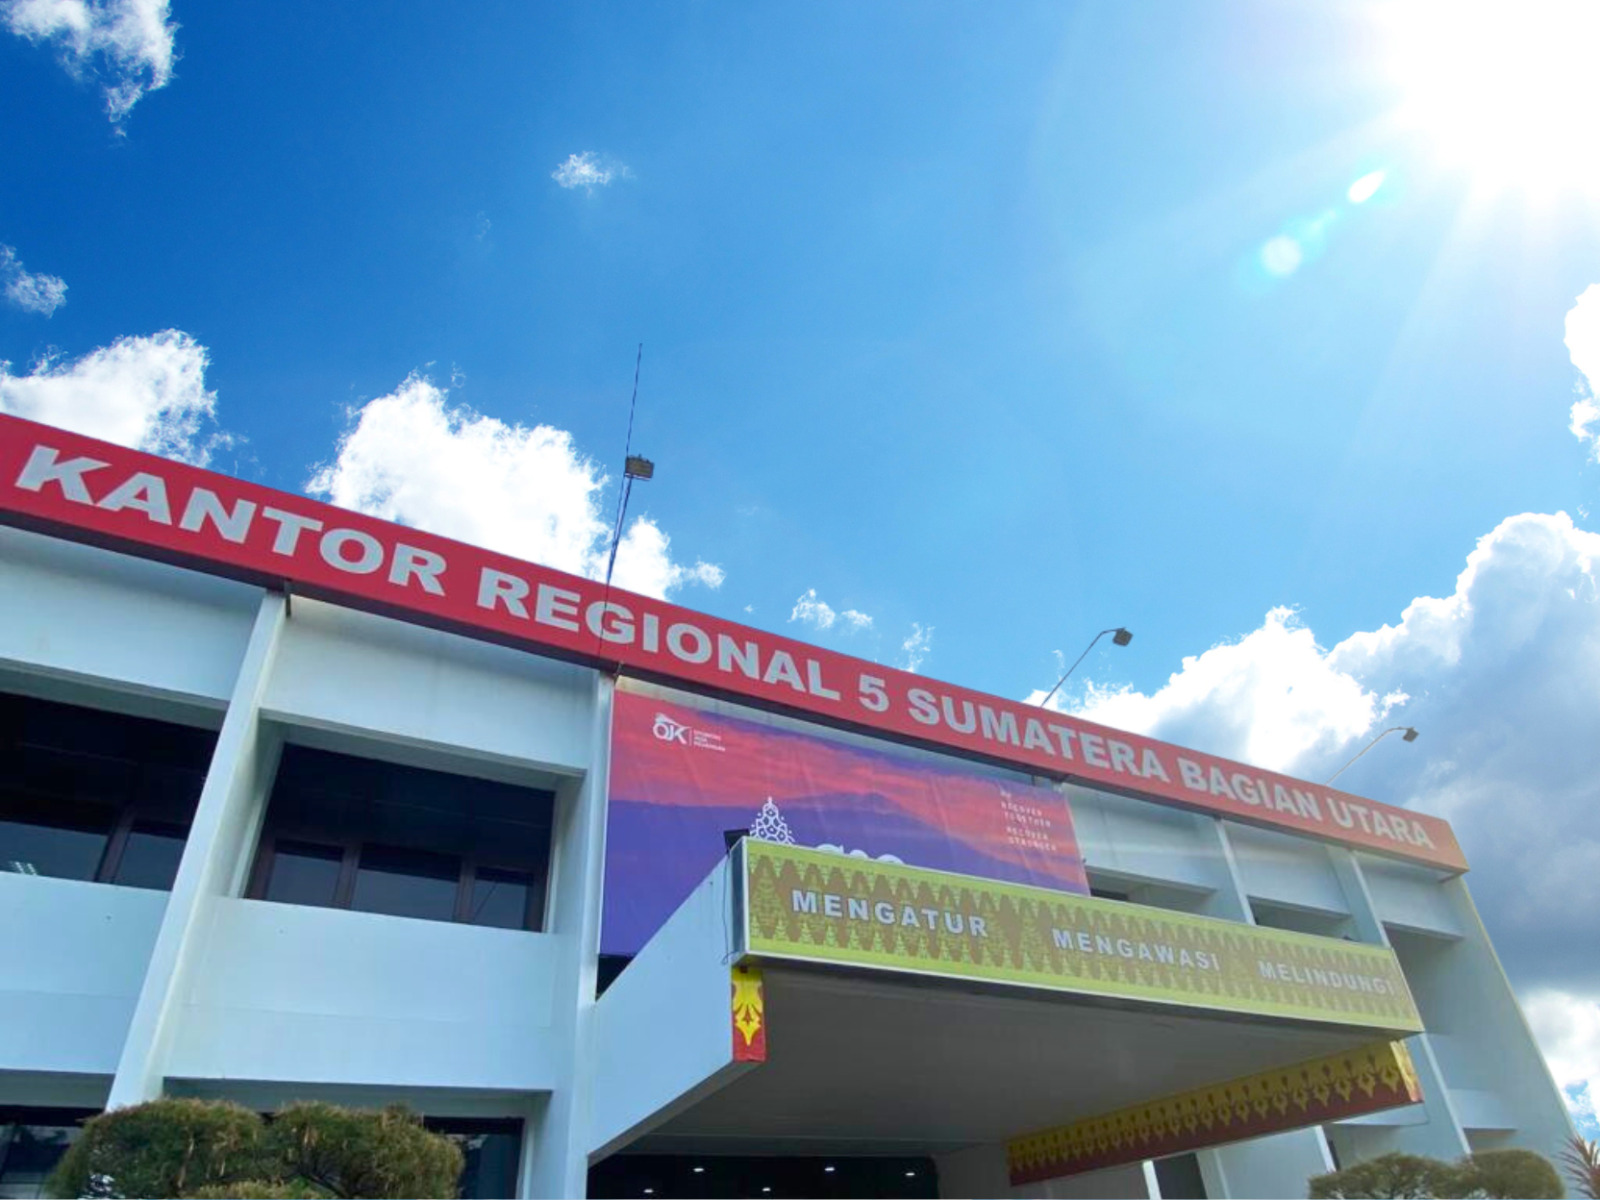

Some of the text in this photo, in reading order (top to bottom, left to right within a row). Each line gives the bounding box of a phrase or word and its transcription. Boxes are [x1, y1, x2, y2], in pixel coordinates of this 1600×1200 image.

[15, 444, 1436, 850] KANTOR REGIONAL 5 SUMATERA BAGIAN UTARA
[652, 719, 691, 746] OJK
[791, 889, 1396, 996] MENGATUR MENGAWASI MELINDUNGI
